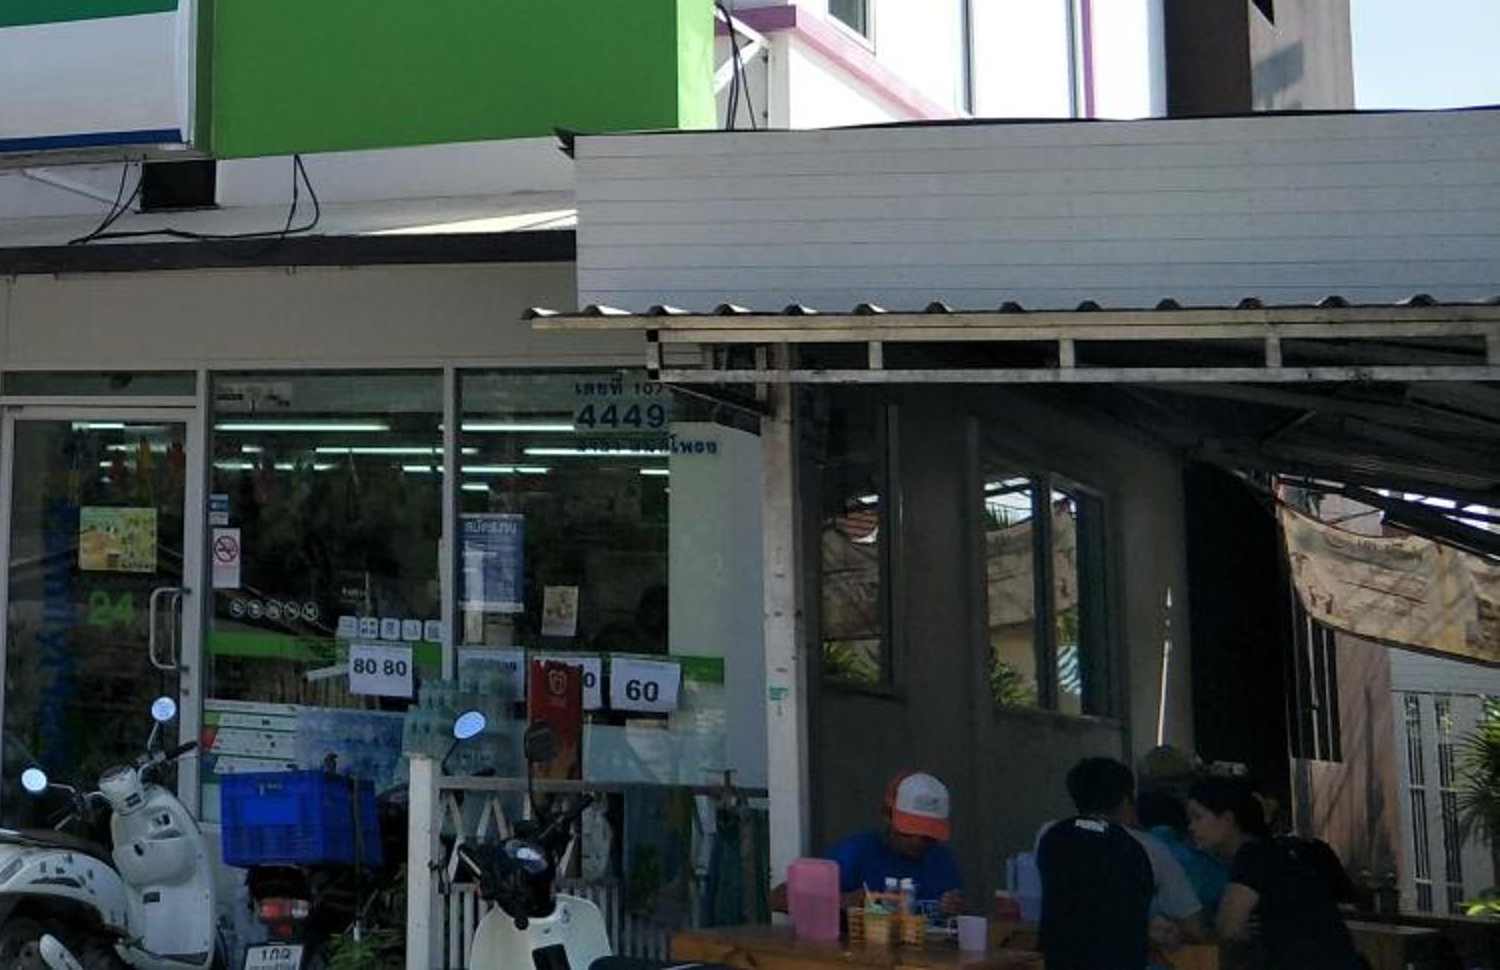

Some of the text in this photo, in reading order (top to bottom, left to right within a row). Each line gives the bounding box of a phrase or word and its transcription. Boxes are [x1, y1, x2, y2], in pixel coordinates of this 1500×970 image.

[577, 403, 666, 429] 4449
[87, 590, 134, 626] 24
[353, 658, 407, 677] 80 80
[626, 679, 659, 703] 60
